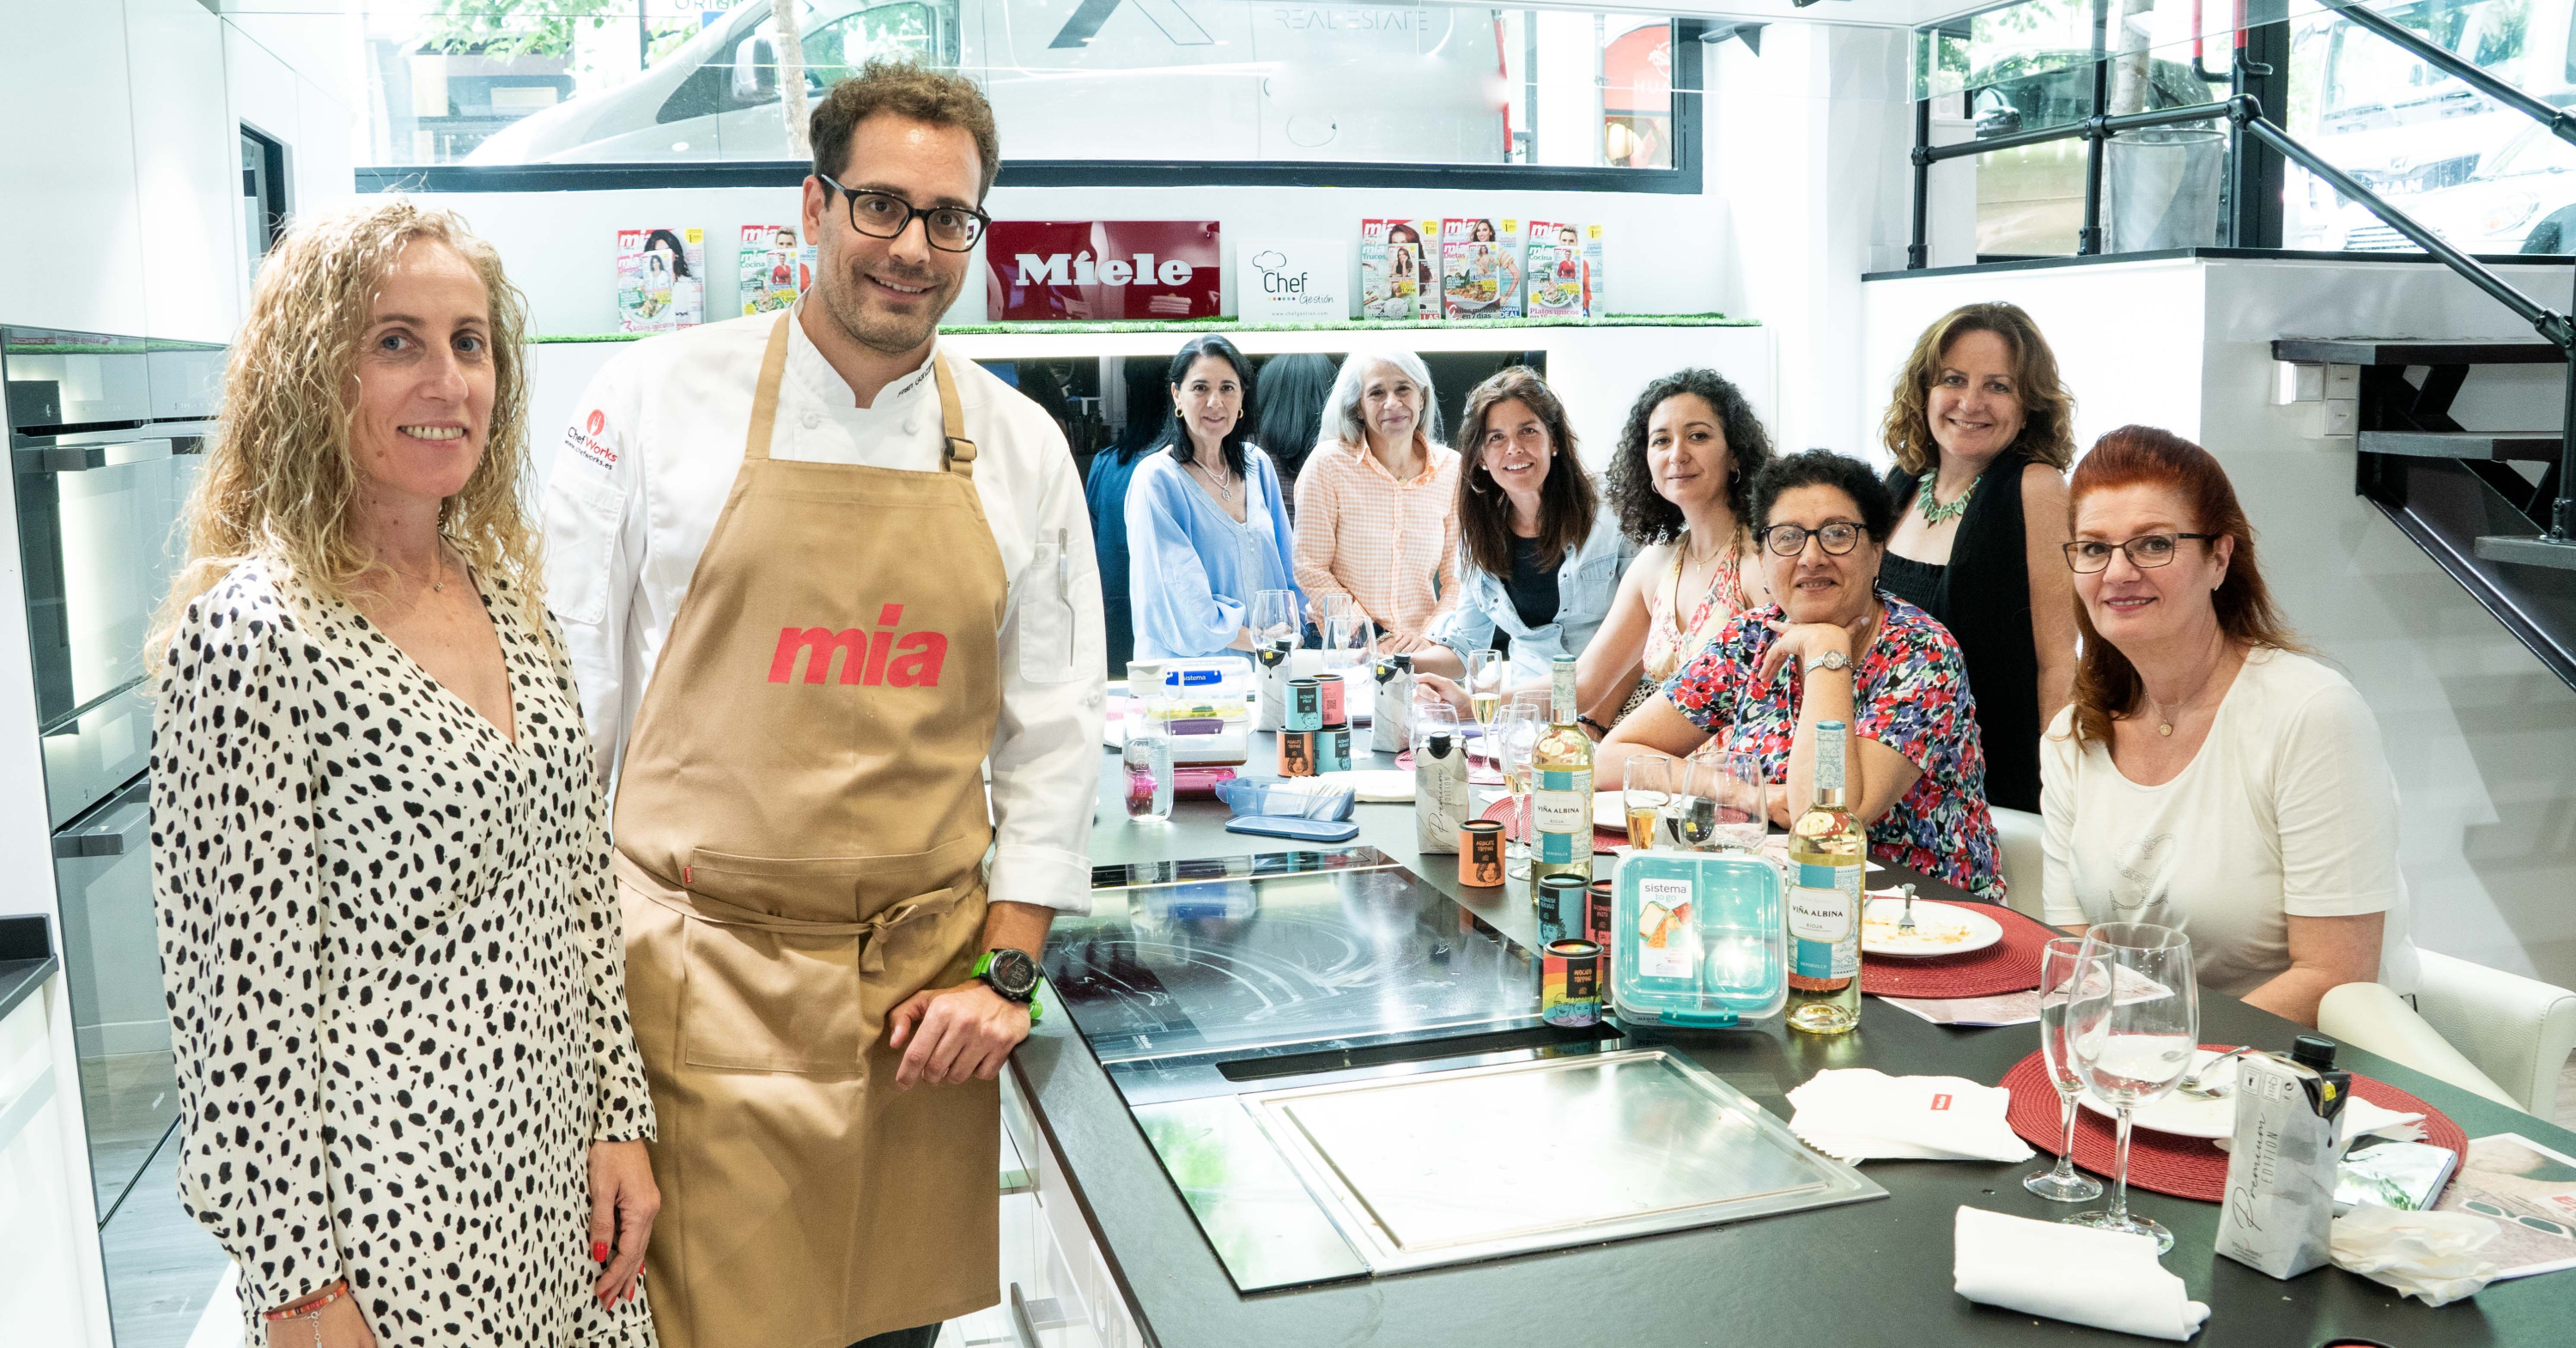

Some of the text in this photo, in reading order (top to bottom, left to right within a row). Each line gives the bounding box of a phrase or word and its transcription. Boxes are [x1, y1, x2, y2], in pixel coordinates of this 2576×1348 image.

[1274, 9, 1428, 31] REAL ESTATE
[1445, 216, 1476, 234] mia
[1015, 250, 1193, 287] Miele
[1264, 272, 1308, 293] Chef
[1299, 293, 1334, 305] Gestión
[565, 440, 612, 470] www.chefworks.es
[568, 427, 617, 462] Chef Works
[767, 603, 948, 689] mia
[1428, 768, 1449, 836] Premium
[1644, 883, 1687, 894] sistema
[1666, 895, 1677, 903] go
[1792, 904, 1808, 915] VIÑA
[2261, 1131, 2278, 1185] EDITION
[2233, 1112, 2266, 1231] Premium
